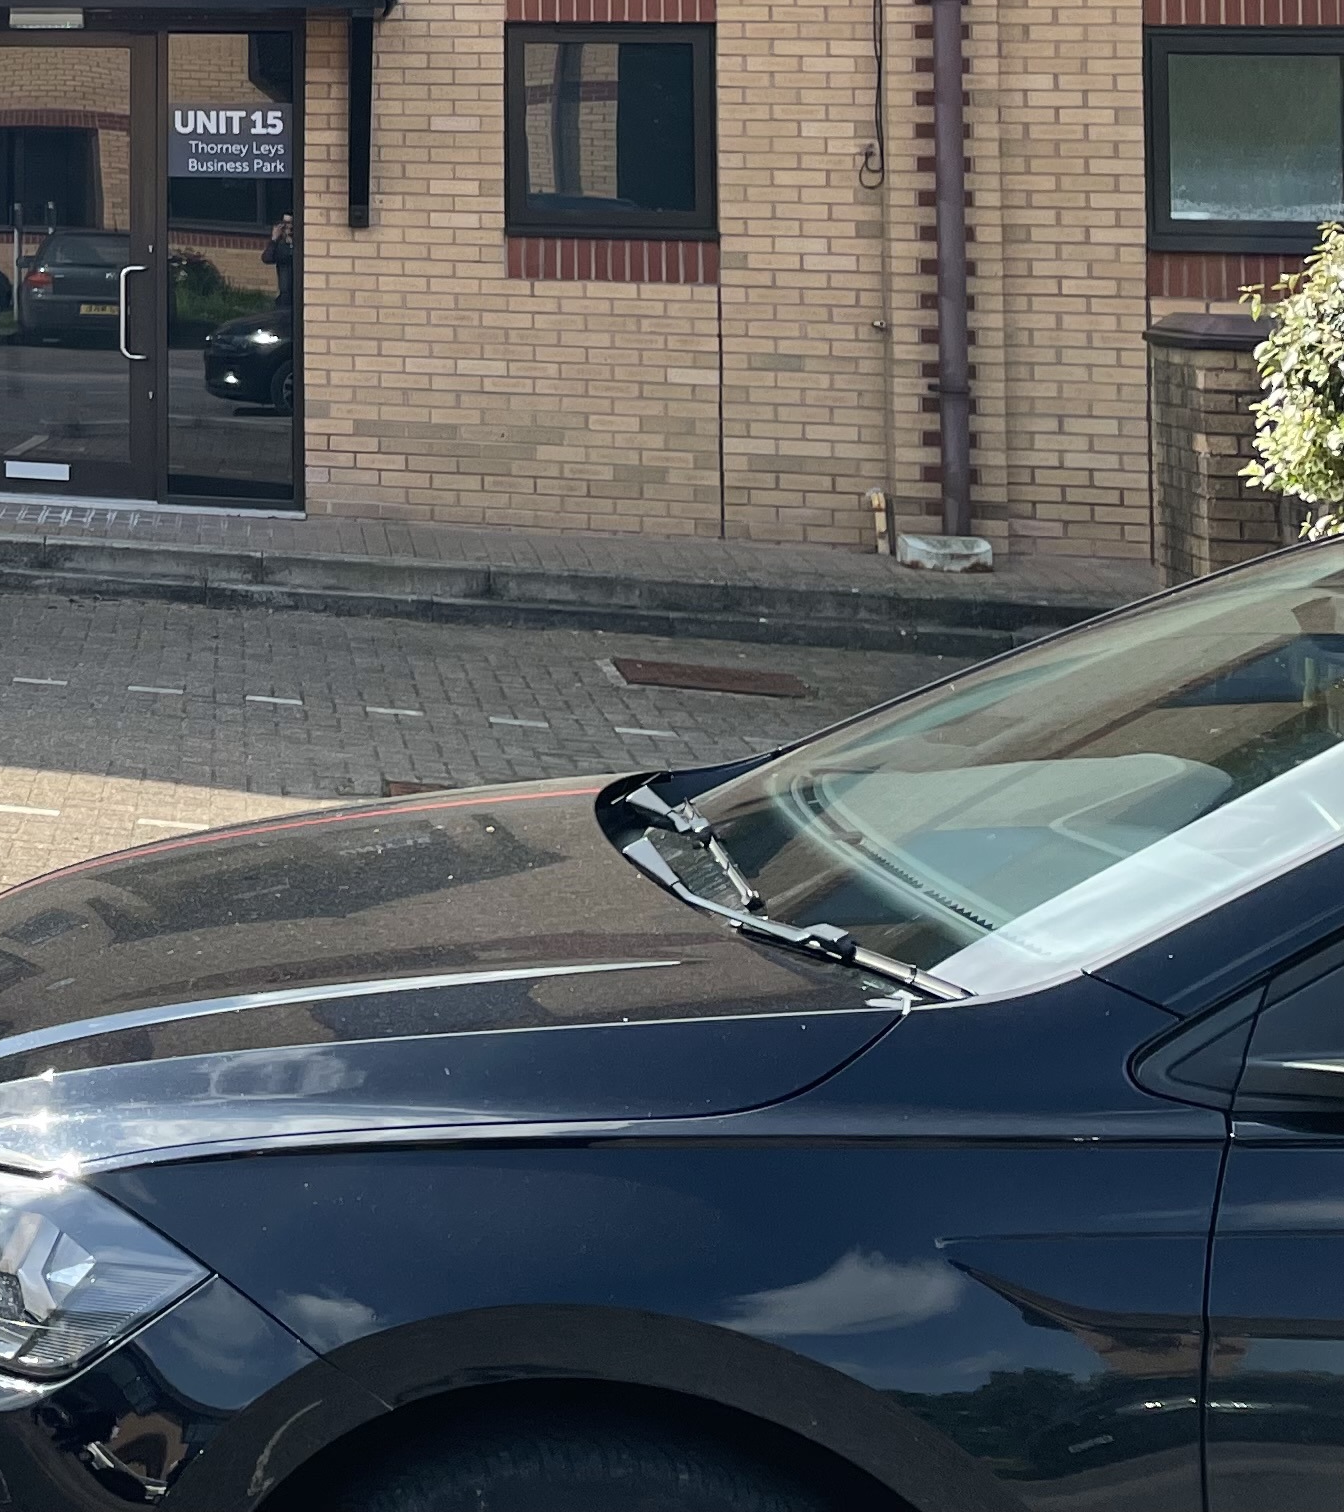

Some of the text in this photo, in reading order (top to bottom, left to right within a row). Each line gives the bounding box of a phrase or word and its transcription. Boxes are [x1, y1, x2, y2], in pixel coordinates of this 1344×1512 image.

[174, 110, 284, 135] UNIT 15
[188, 140, 285, 157] Thorney Leys
[188, 158, 285, 172] Business Park
